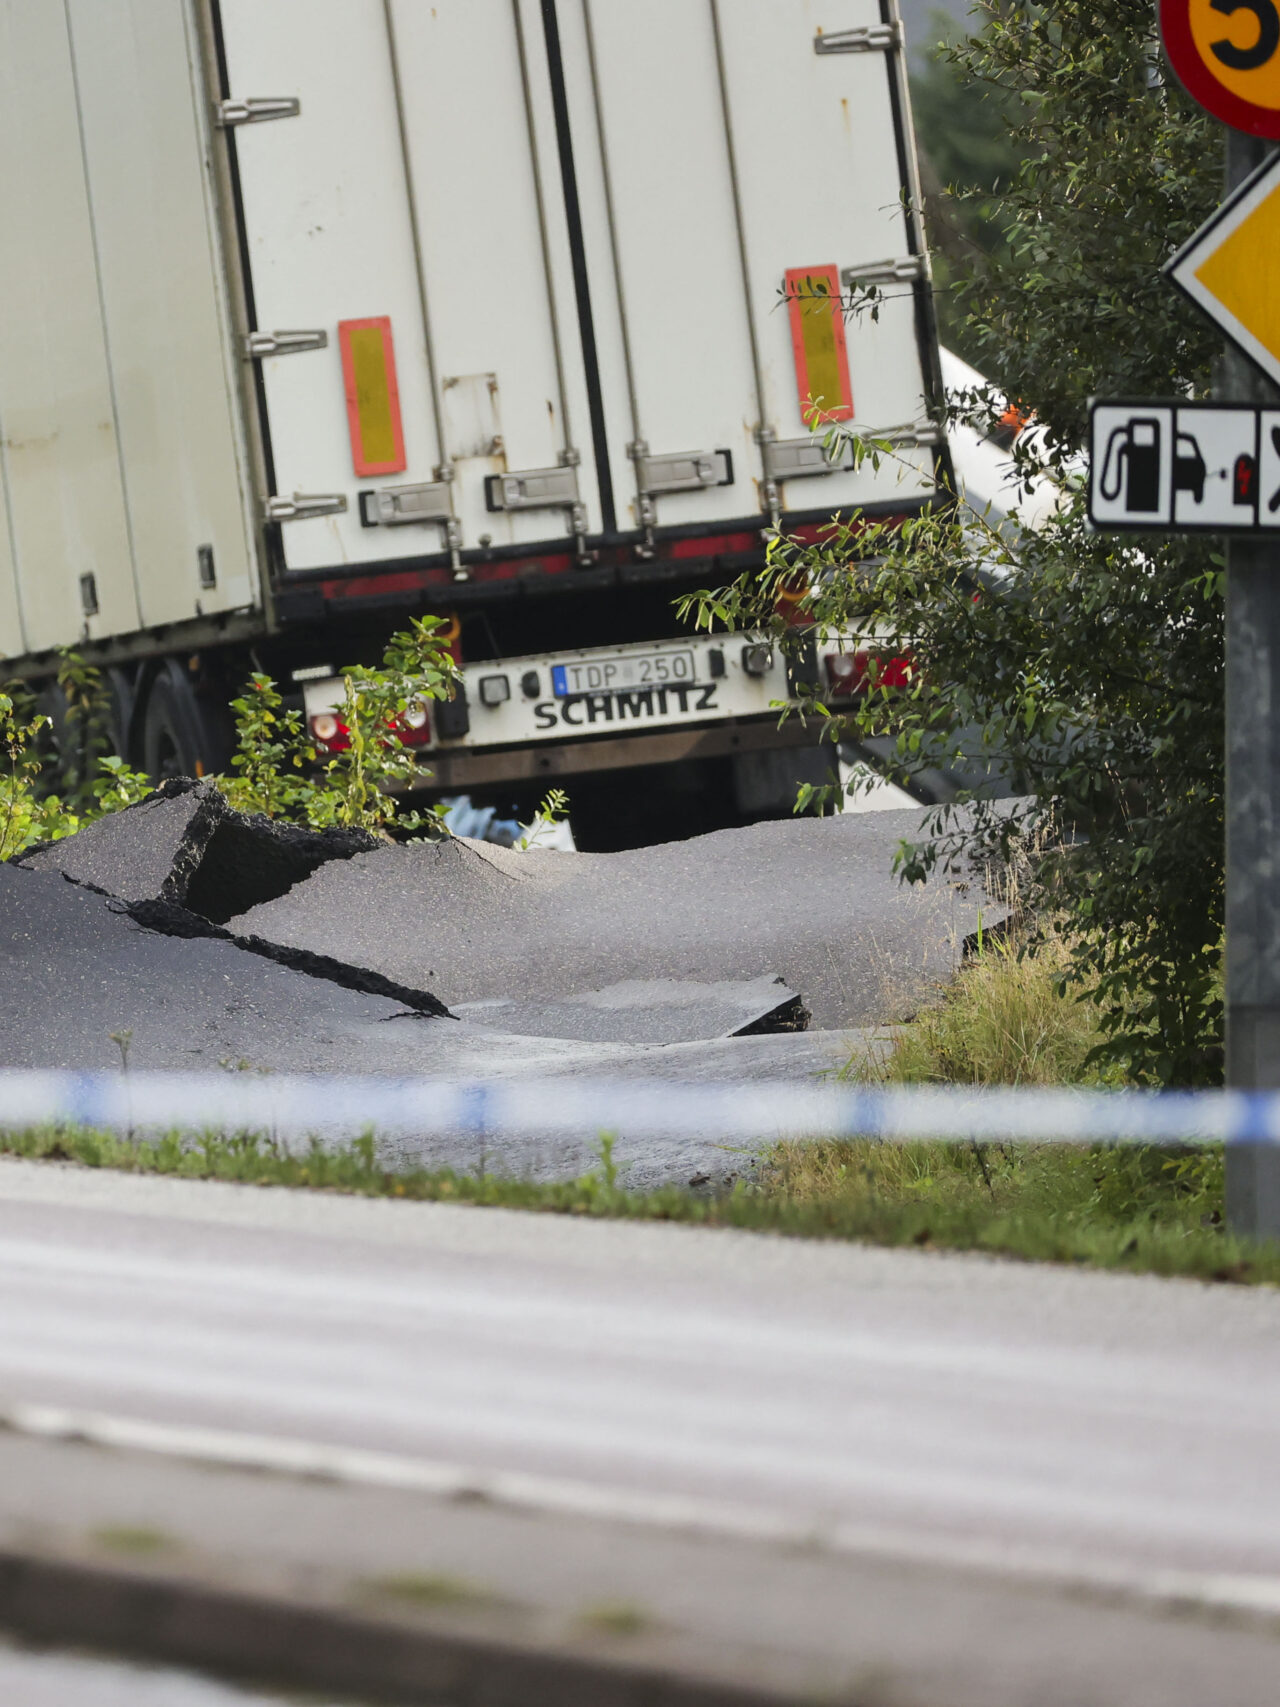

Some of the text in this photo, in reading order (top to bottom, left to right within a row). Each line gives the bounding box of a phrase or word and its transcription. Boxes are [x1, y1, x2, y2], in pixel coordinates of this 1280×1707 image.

[570, 656, 688, 690] TDP 250
[534, 683, 718, 729] SCHMITZ
